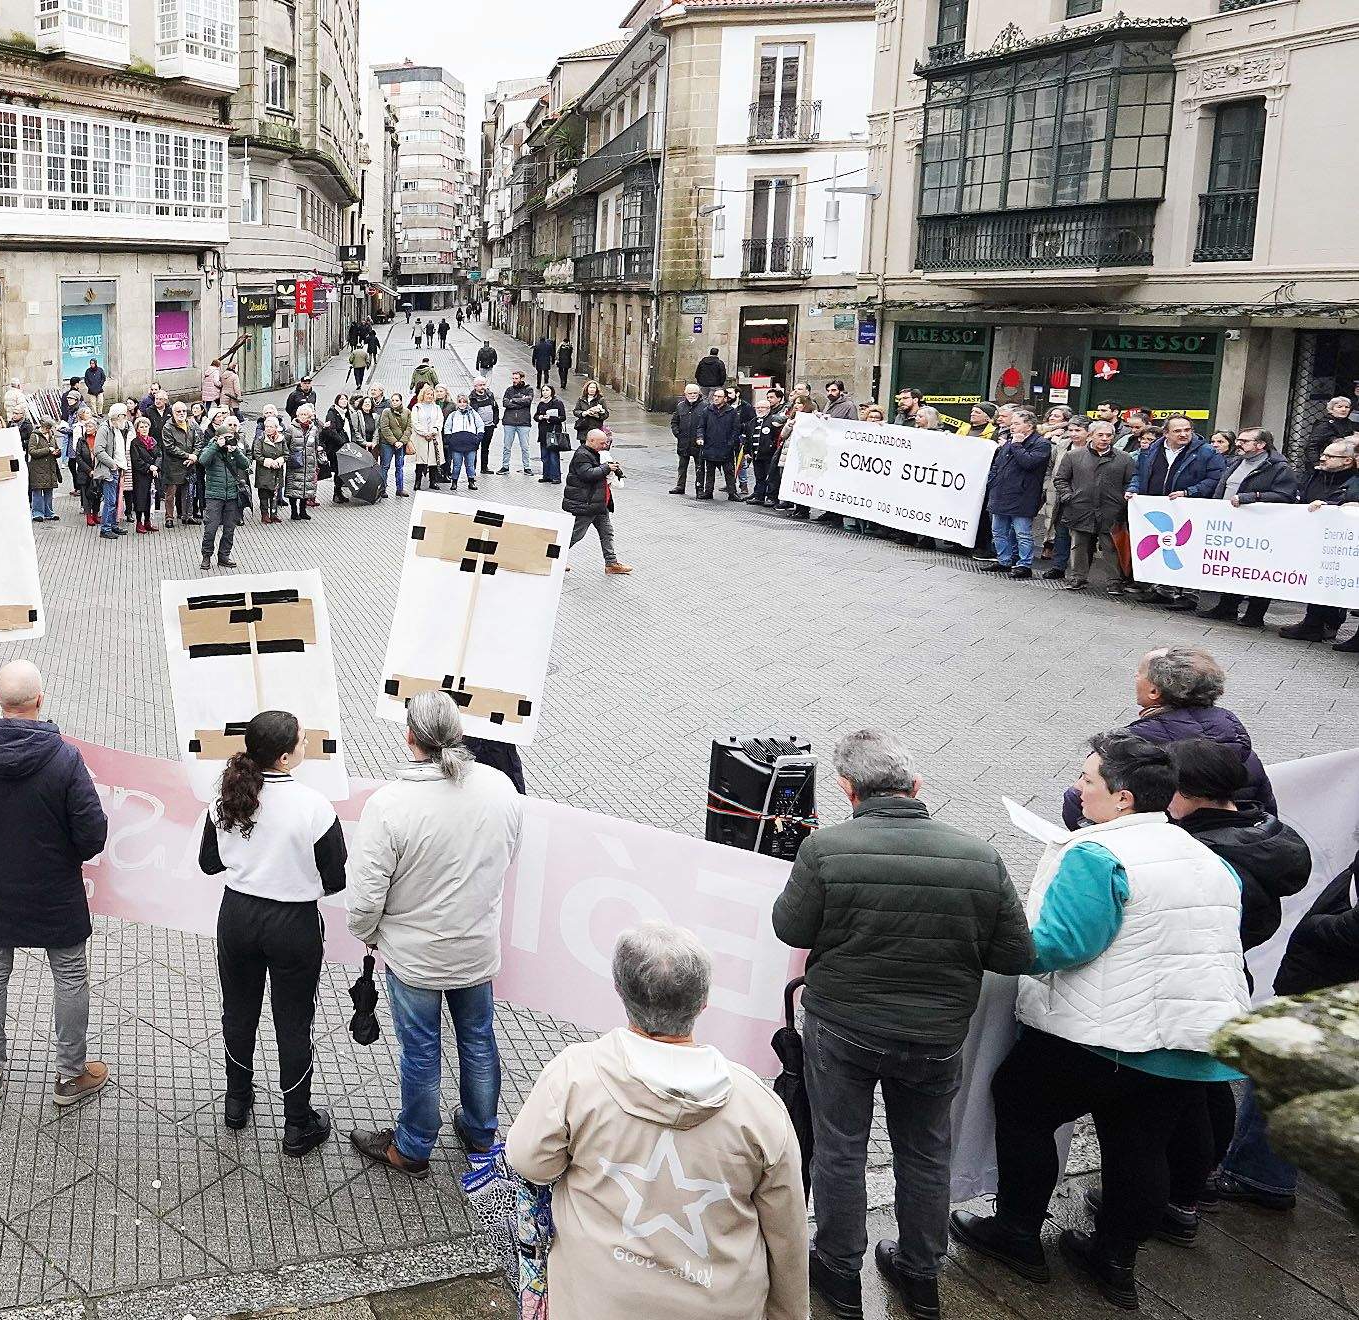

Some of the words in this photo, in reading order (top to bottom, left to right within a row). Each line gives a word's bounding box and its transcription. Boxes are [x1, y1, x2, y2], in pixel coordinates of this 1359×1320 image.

[905, 328, 974, 344] ARESSO
[1101, 334, 1201, 352] ARESSO
[844, 430, 912, 450] COORDINADORA
[839, 451, 892, 477] SOMOS
[901, 463, 966, 491] SUÍDO
[792, 480, 813, 497] NON
[818, 488, 824, 498] O
[829, 491, 873, 508] ESPOLIO
[895, 506, 932, 523] NOSOS
[1206, 519, 1233, 533] NIN
[1204, 534, 1273, 554] ESPOLIO,
[1203, 548, 1230, 562] NIN
[1202, 563, 1308, 586] DEPREDACIÓN
